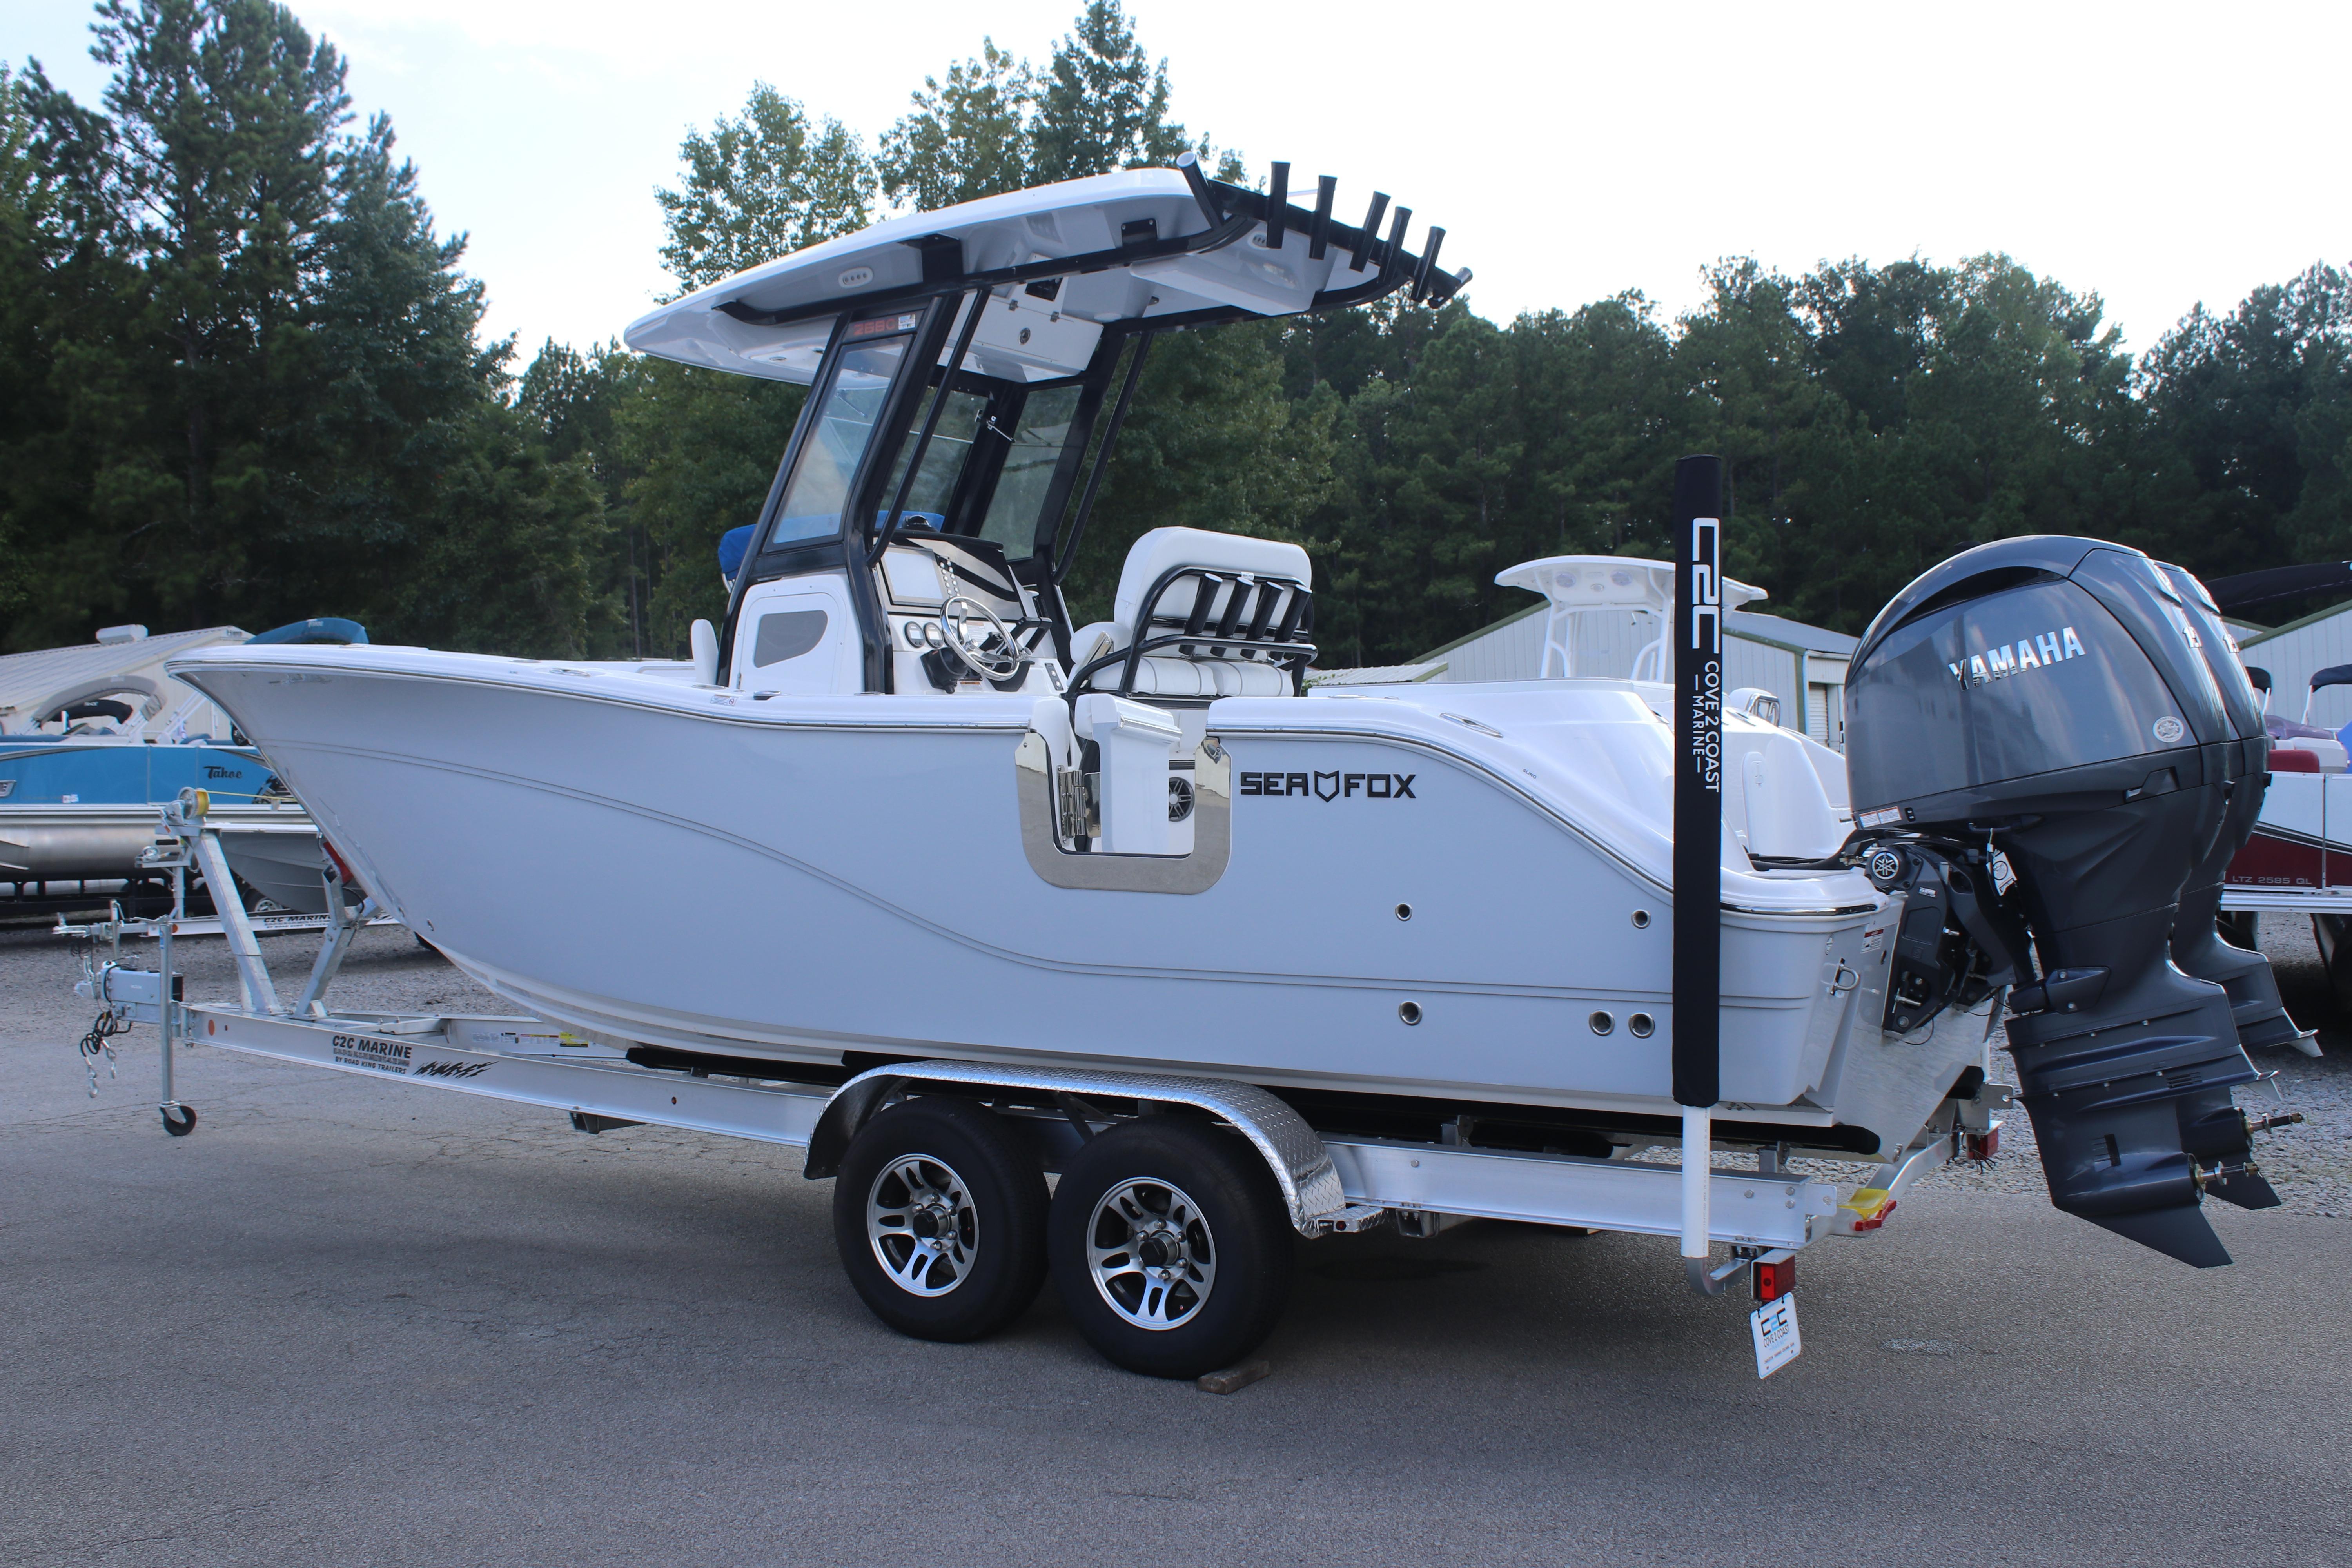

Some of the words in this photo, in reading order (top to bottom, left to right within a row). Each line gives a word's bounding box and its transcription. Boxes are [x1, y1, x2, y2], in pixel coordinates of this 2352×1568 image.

[1947, 626, 2086, 691] YAMAHA
[1704, 661, 1720, 711] COVE
[1692, 695, 1705, 755] MARINE
[1705, 716, 1719, 726] 2
[203, 766, 243, 779] Tahoe
[1705, 731, 1720, 793] COAST
[1240, 771, 1309, 797] SEA
[1344, 773, 1417, 799] FOX
[332, 1035, 355, 1049] C2C
[358, 1039, 412, 1059] MARINE
[361, 1060, 376, 1069] KING
[378, 1063, 407, 1074] TRAILERS
[1760, 1307, 1788, 1337] C2C
[1763, 1335, 1775, 1348] COVE
[1774, 1332, 1777, 1341] 2
[1777, 1324, 1790, 1339] COAST
